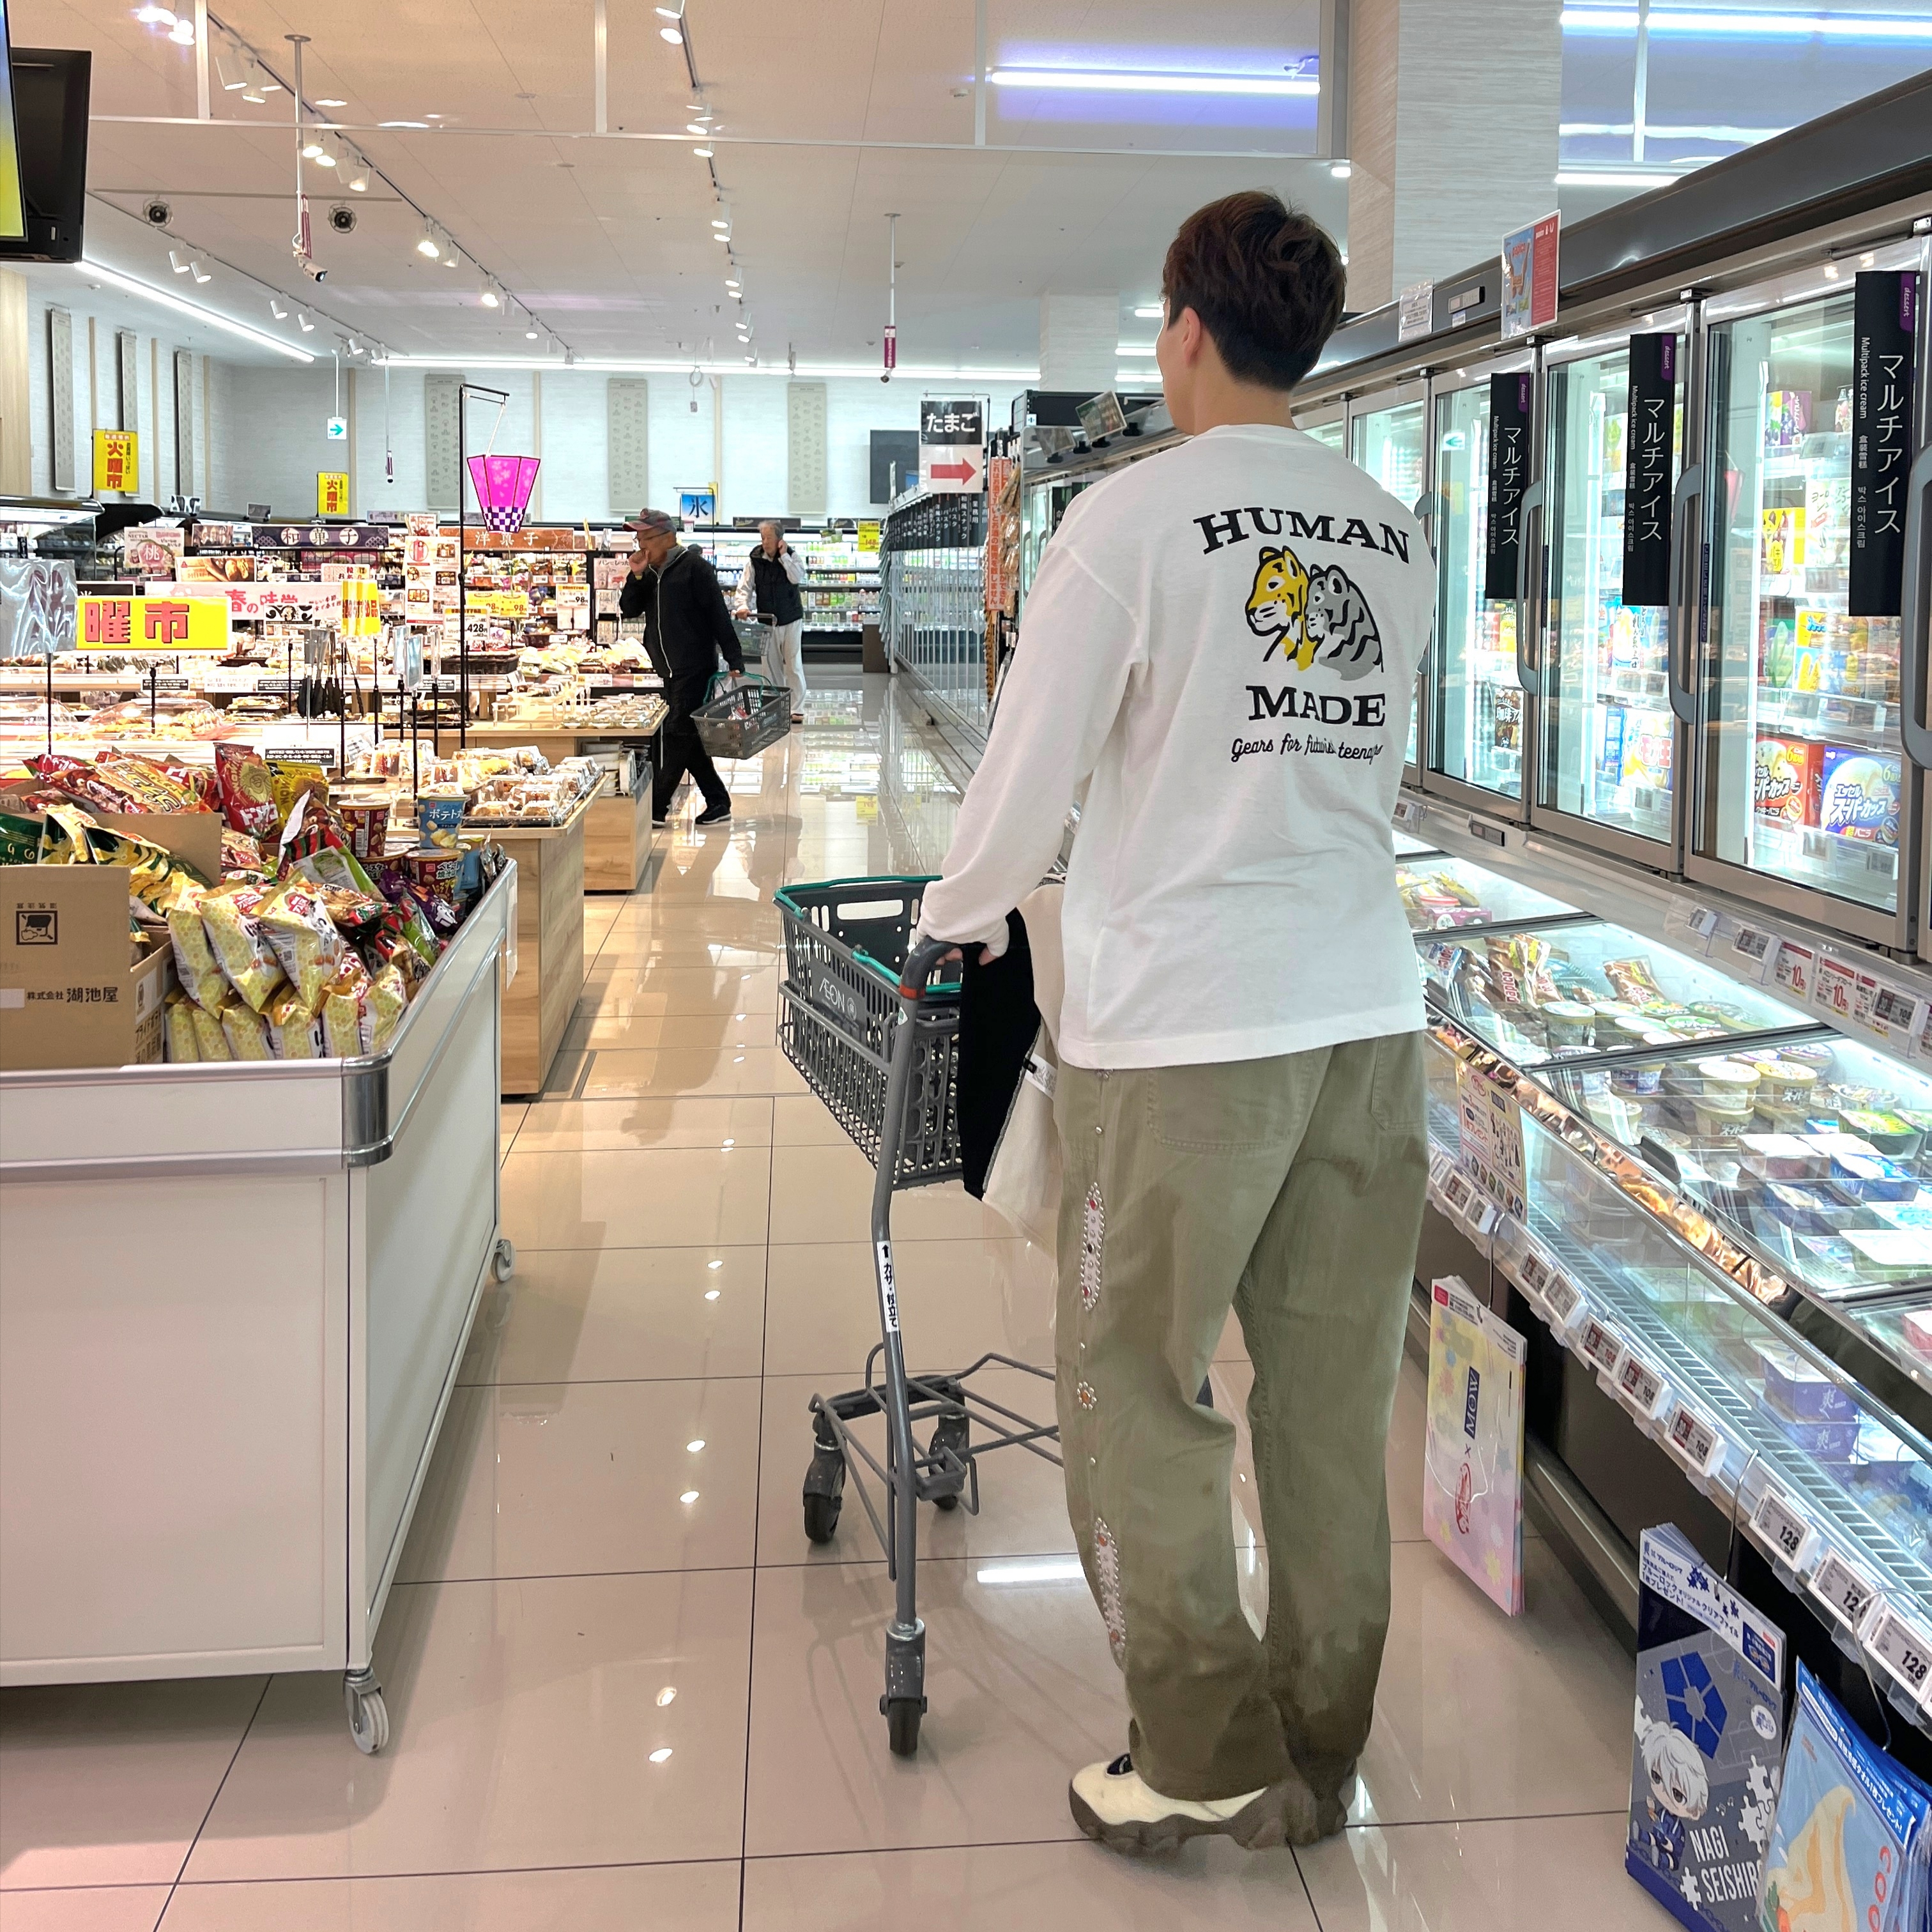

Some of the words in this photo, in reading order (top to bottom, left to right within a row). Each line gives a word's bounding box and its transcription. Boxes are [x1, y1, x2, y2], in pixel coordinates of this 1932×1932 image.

[1860, 336, 1871, 378] Multipack
[1859, 393, 1867, 419] cream
[926, 412, 977, 433] たまご
[1874, 355, 1905, 534] マルチアイス
[107, 441, 123, 489] 火曜市
[1640, 399, 1665, 540] マルチアイス
[1501, 427, 1521, 545] マルチアイス
[689, 496, 709, 518] 氷
[282, 528, 357, 545] 和菓子
[475, 531, 539, 546] 洋菓子
[1193, 507, 1409, 565] HUMAN
[144, 544, 160, 561] 桃
[85, 601, 189, 644] 曜市
[1246, 685, 1386, 727] MADE
[1231, 737, 1274, 762] Gears
[1280, 733, 1302, 756] for
[1835, 785, 1862, 799] エッセル
[1829, 797, 1887, 827] スーパーカップ
[26, 986, 119, 1003] 株式会社湖池屋
[1501, 970, 1521, 1004] papico
[1779, 1525, 1799, 1551] 128
[1901, 1650, 1928, 1680] 128
[1689, 1825, 1729, 1863] NAGI
